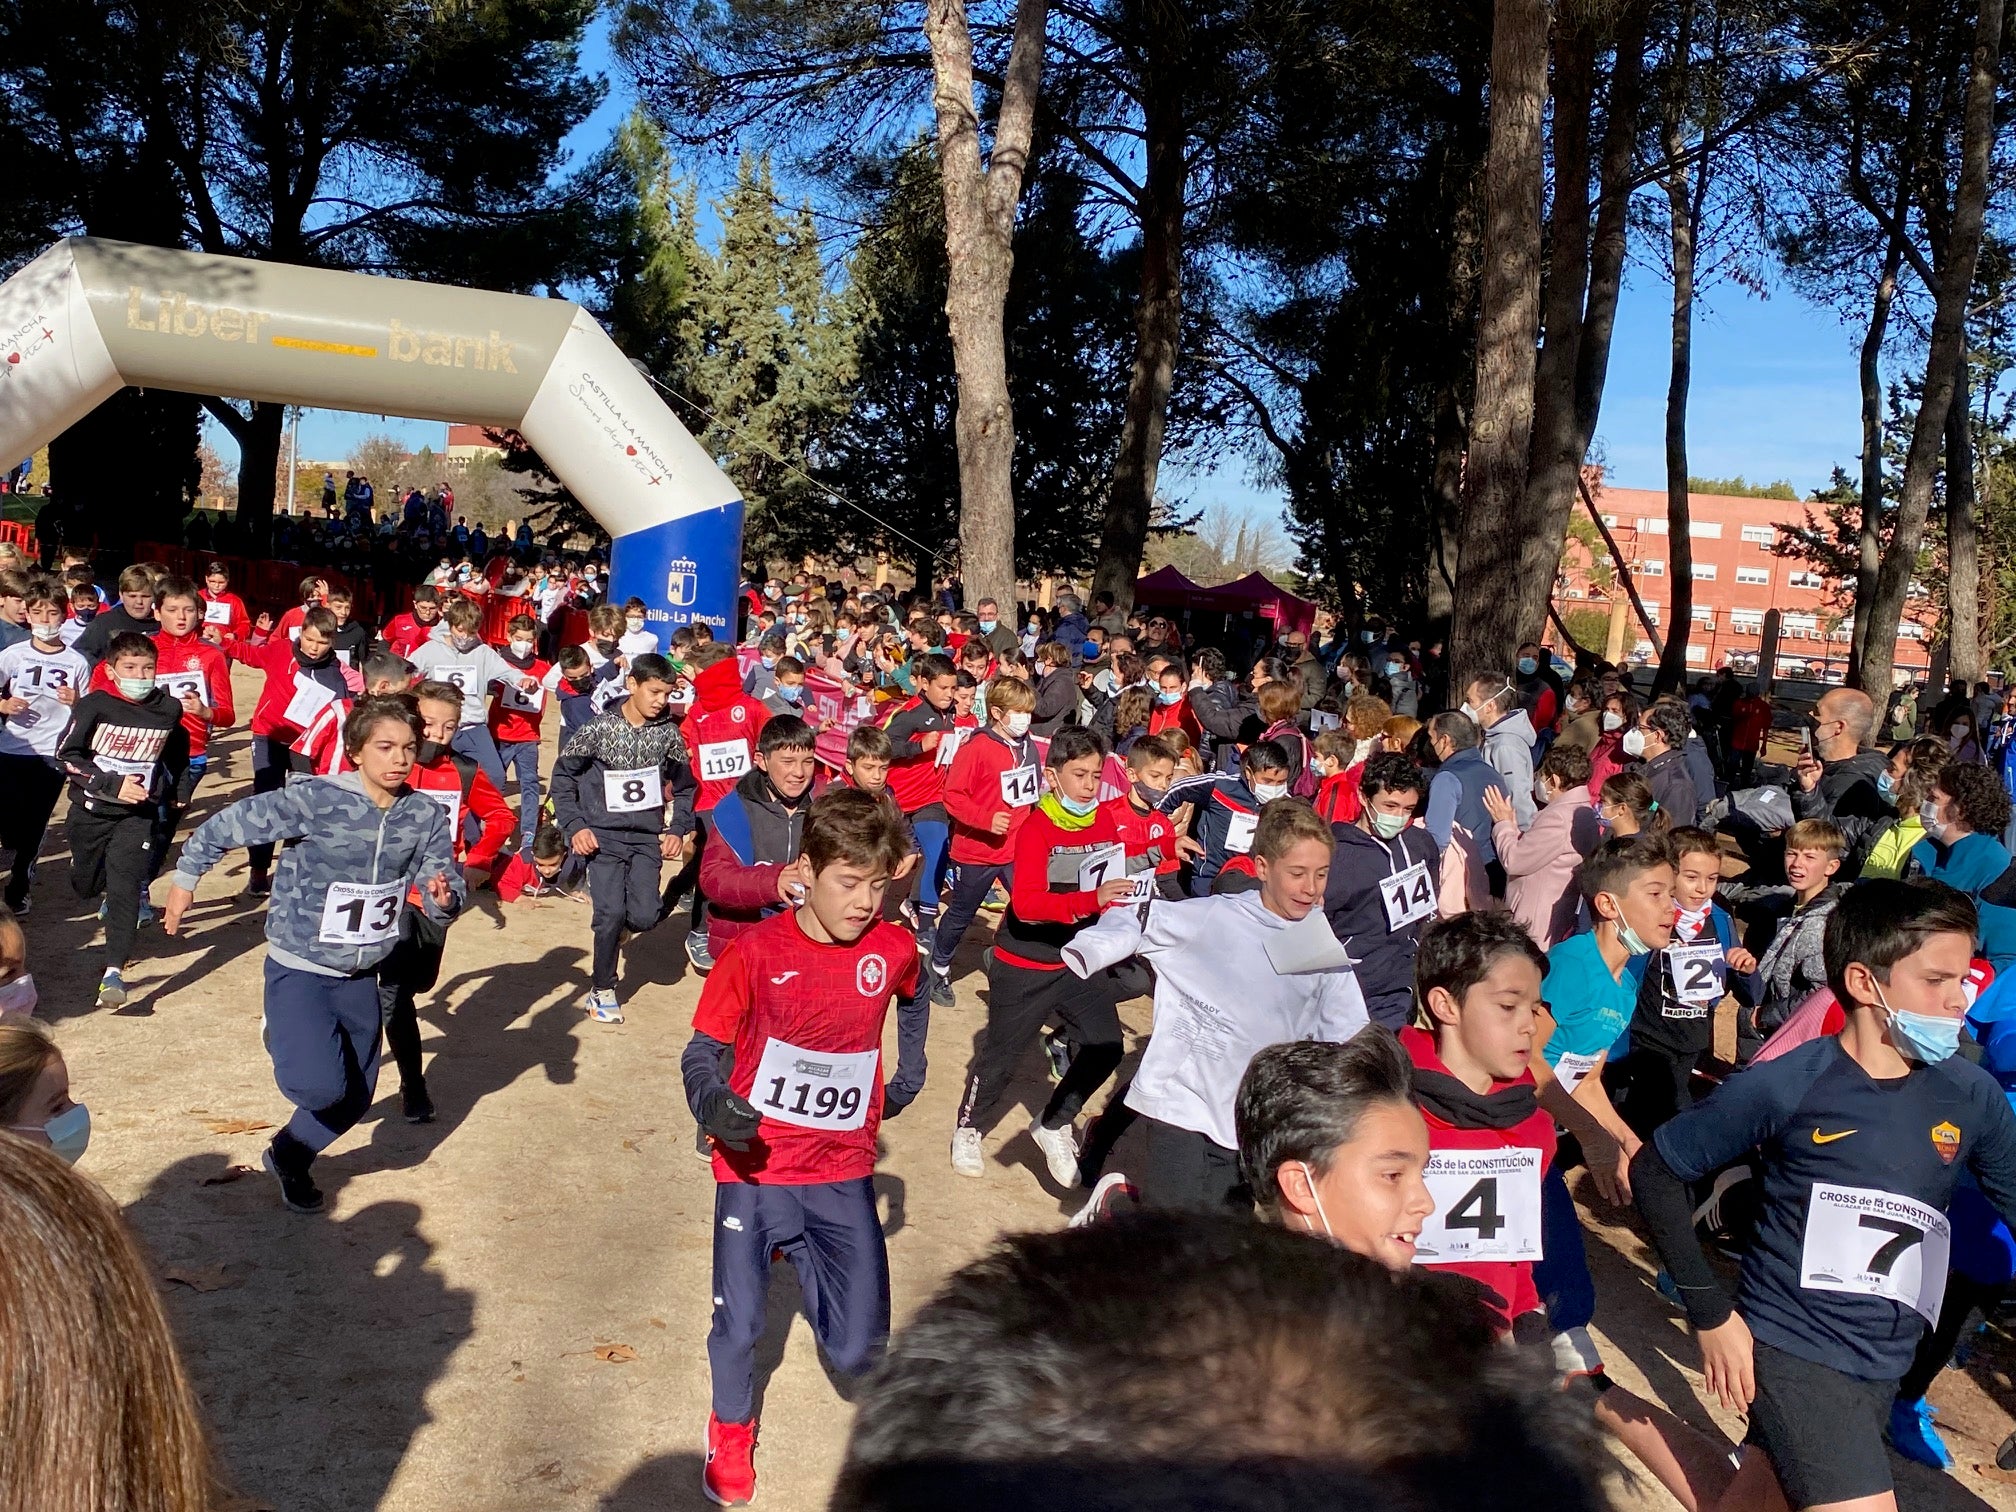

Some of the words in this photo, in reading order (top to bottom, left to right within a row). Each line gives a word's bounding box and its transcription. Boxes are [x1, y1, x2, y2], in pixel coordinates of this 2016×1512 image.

[126, 286, 270, 344] Liber
[387, 319, 519, 375] bank
[633, 435, 673, 481] MANCHA
[646, 609, 687, 624] tilla-La
[690, 612, 726, 627] Mancha
[25, 665, 68, 690] 13
[447, 672, 465, 689] 6
[706, 754, 745, 775] 1197
[622, 779, 646, 803] 8
[1007, 773, 1036, 800] 14
[1089, 859, 1109, 888] 7
[333, 885, 355, 894] CROSS
[1391, 874, 1431, 916] 14
[336, 896, 398, 933] 13
[1683, 958, 1713, 991] 2
[1664, 1008, 1692, 1018] MARIO
[764, 1076, 861, 1121] 1199
[1444, 1159, 1456, 1169] de
[1457, 1159, 1467, 1169] la
[1468, 1155, 1534, 1169] CONSTITUCIÓN
[1445, 1177, 1505, 1239] 4
[1820, 1191, 1857, 1205] CROSS
[1858, 1196, 1872, 1206] de
[1874, 1197, 1883, 1208] la
[1858, 1213, 1925, 1277] 7
